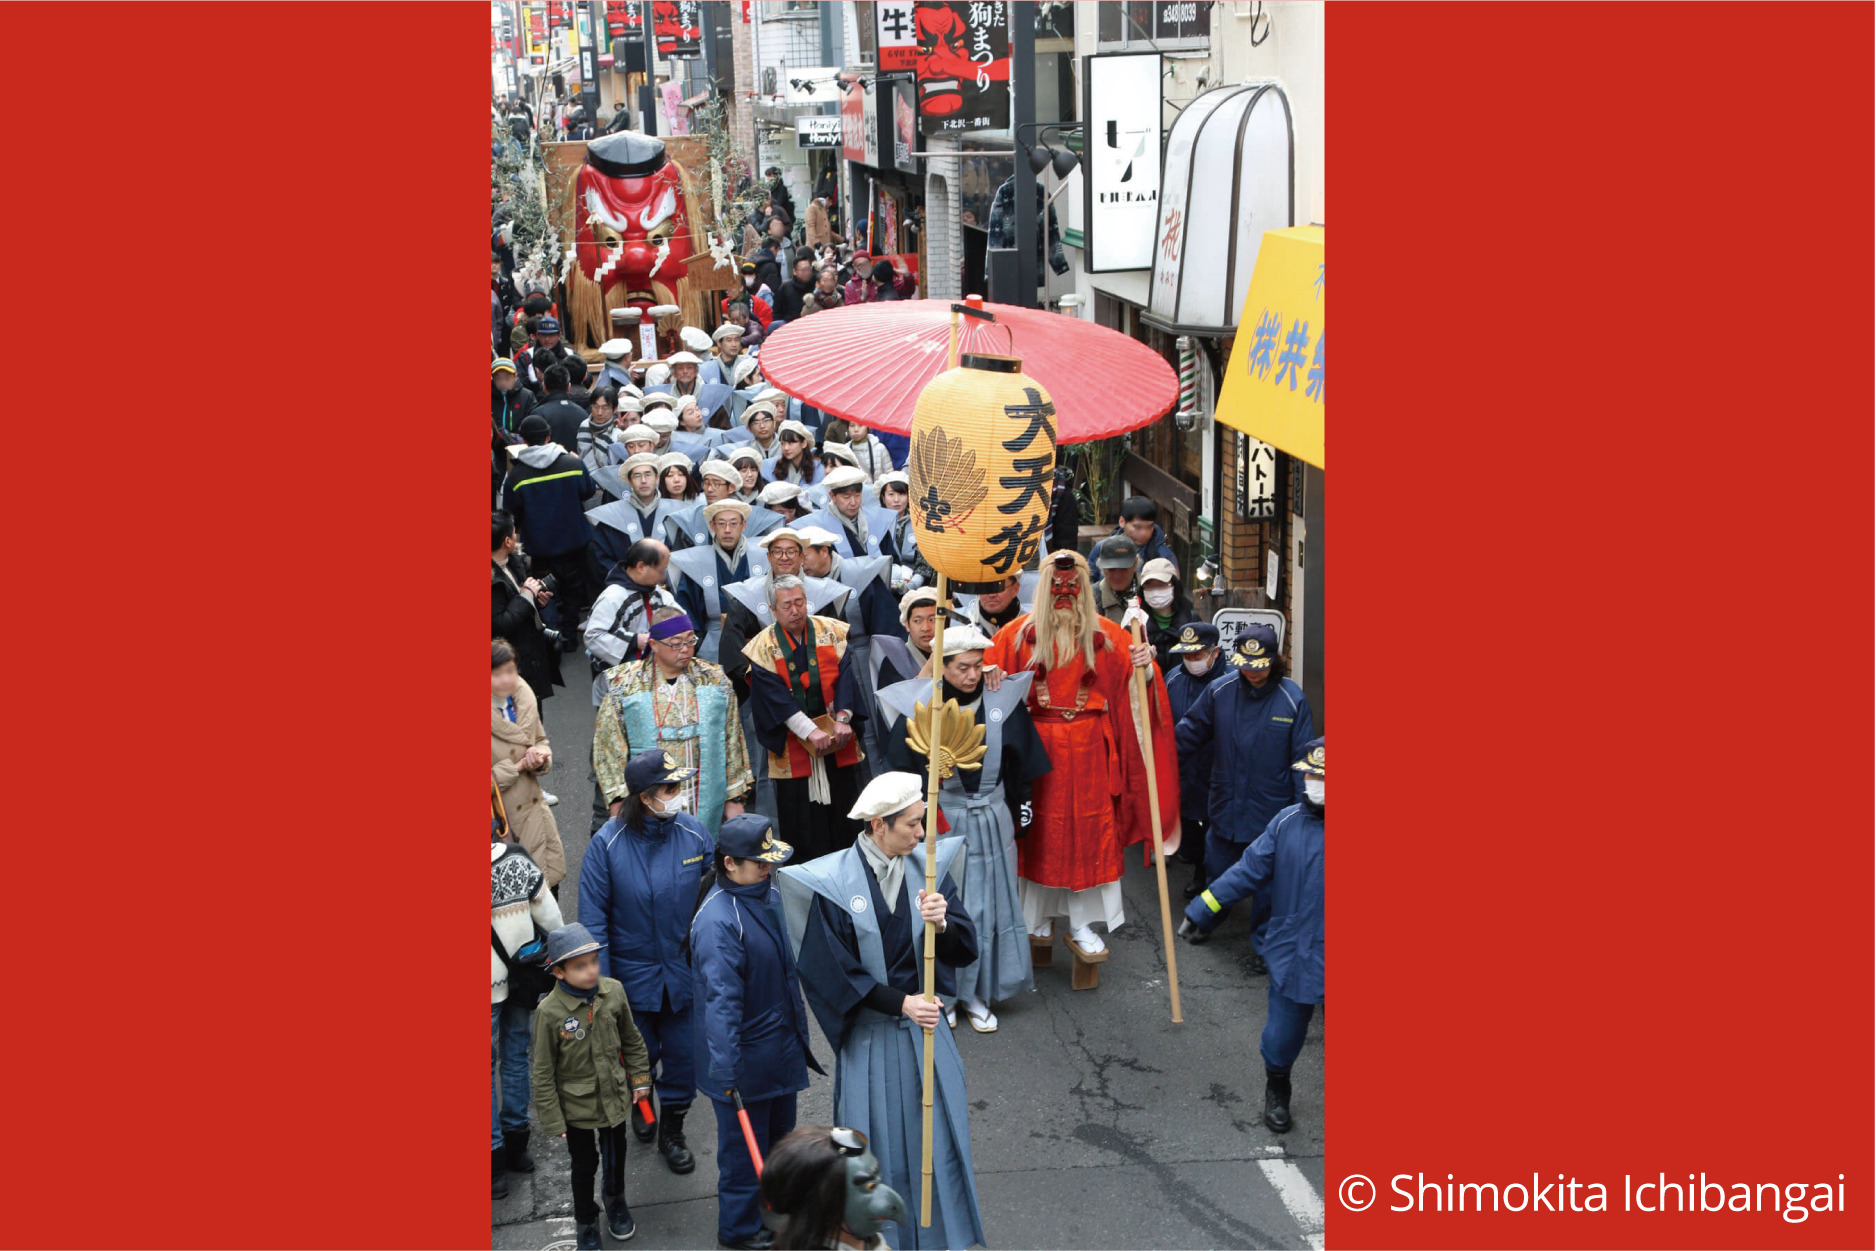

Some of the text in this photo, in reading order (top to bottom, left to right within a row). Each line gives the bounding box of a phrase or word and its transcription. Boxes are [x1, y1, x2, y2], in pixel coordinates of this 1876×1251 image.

[942, 117, 990, 130] 下北沢一番街
[980, 387, 1057, 574] 大天狗
[1220, 621, 1275, 636] 不動の
